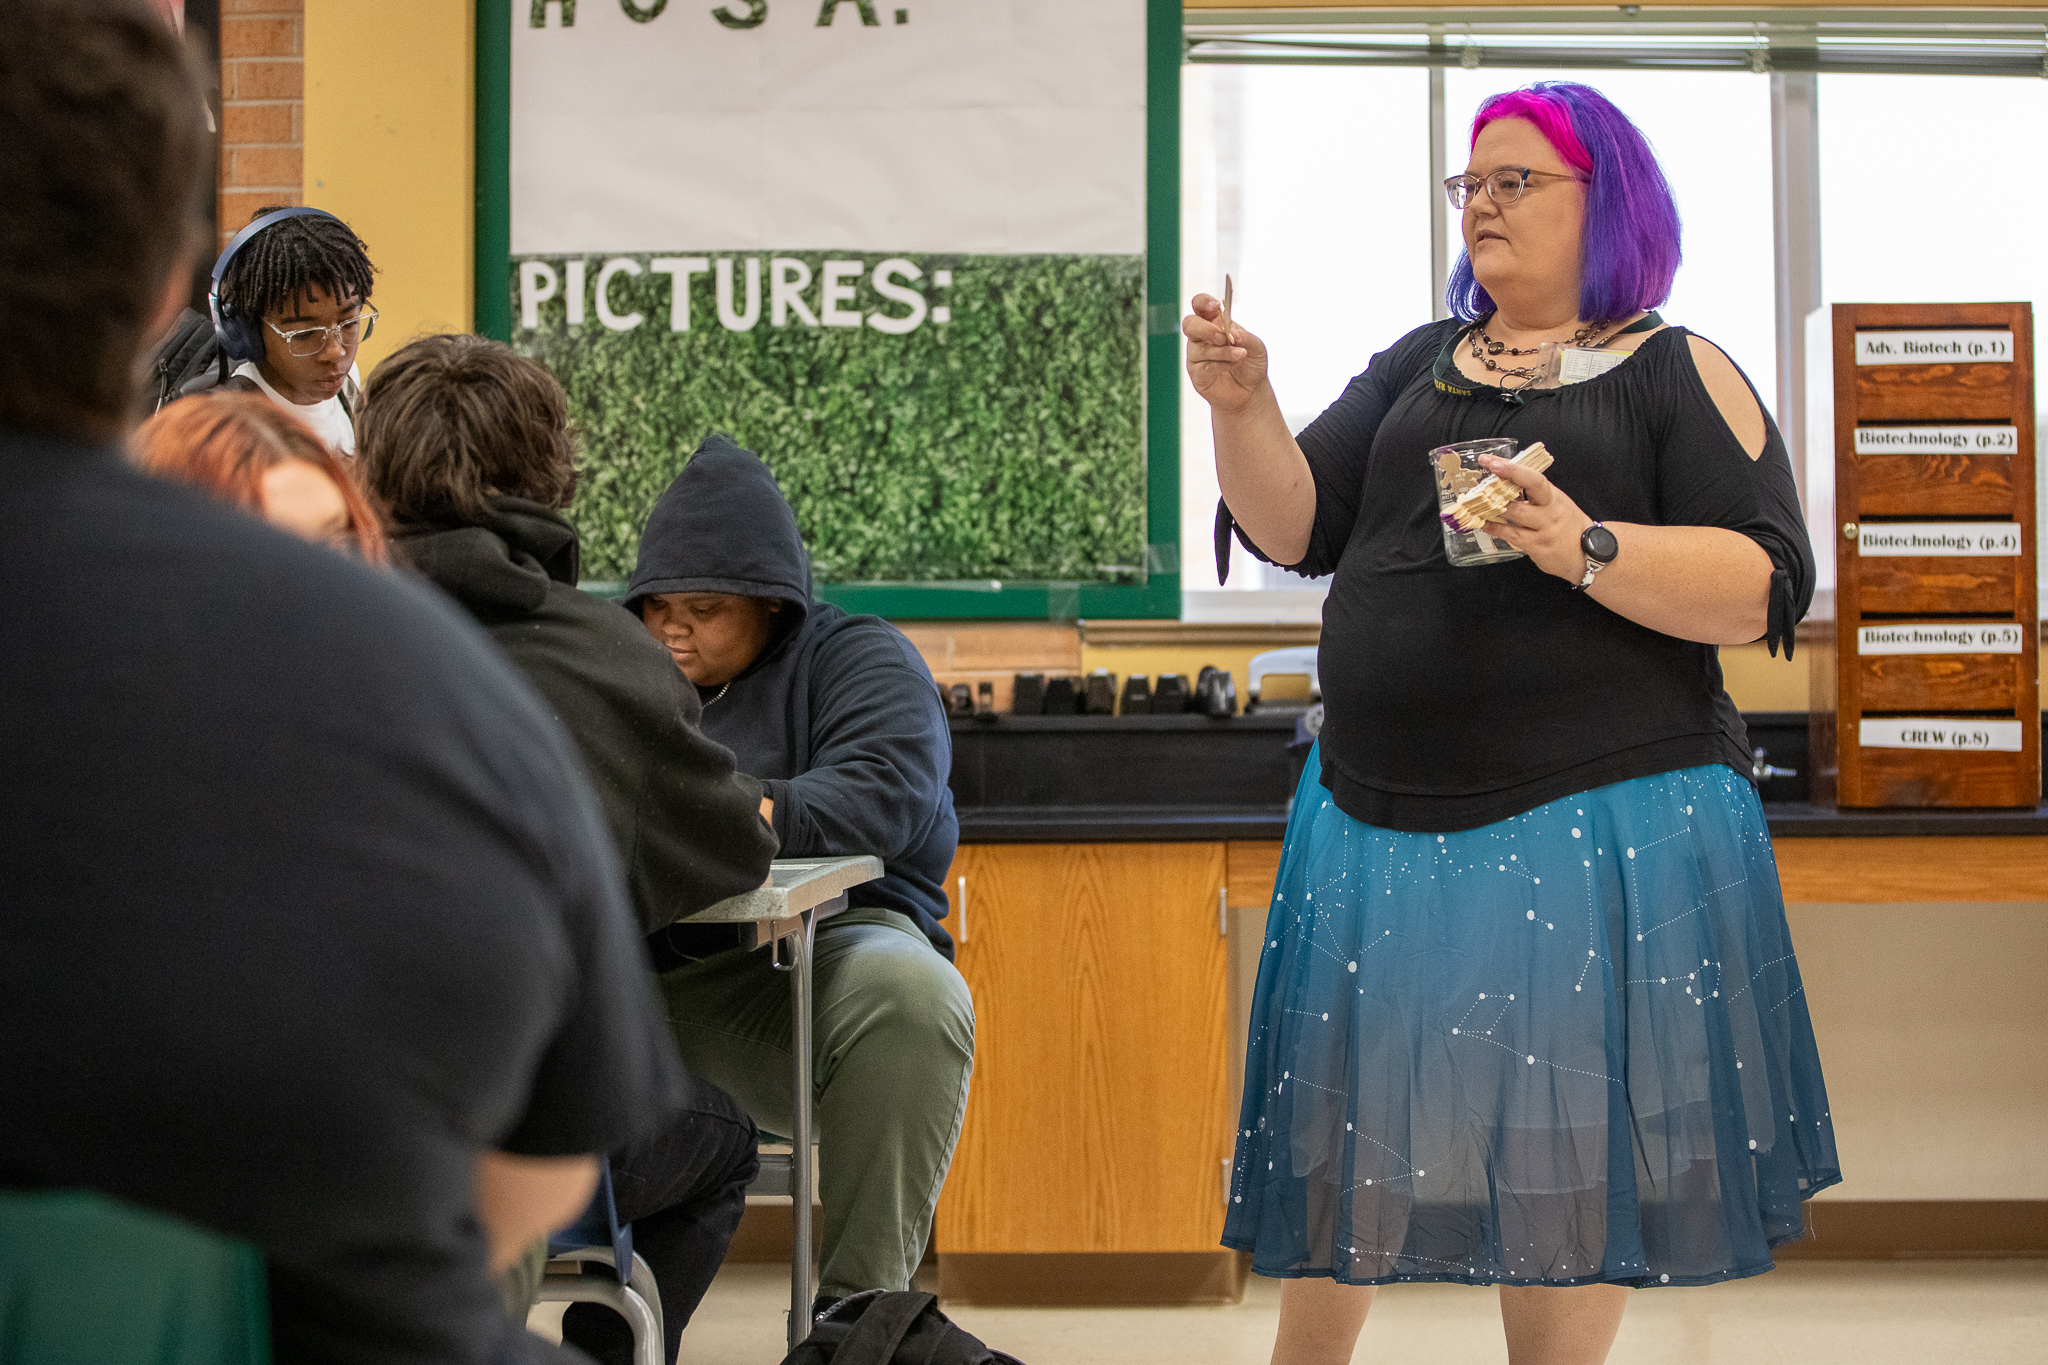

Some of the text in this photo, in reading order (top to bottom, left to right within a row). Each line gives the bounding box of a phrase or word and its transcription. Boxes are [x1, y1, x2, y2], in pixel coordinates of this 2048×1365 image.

[519, 257, 952, 334] PICTURES:
[1866, 341, 2006, 356] Adv. Biotech (p.1)
[1859, 431, 2014, 448] Biotechnology (p.2)
[1863, 533, 2017, 550] Biotechnology (p.4)
[1865, 629, 2019, 645] Biotechnology (p.5)
[1901, 730, 1990, 748] CREW (p.8)
